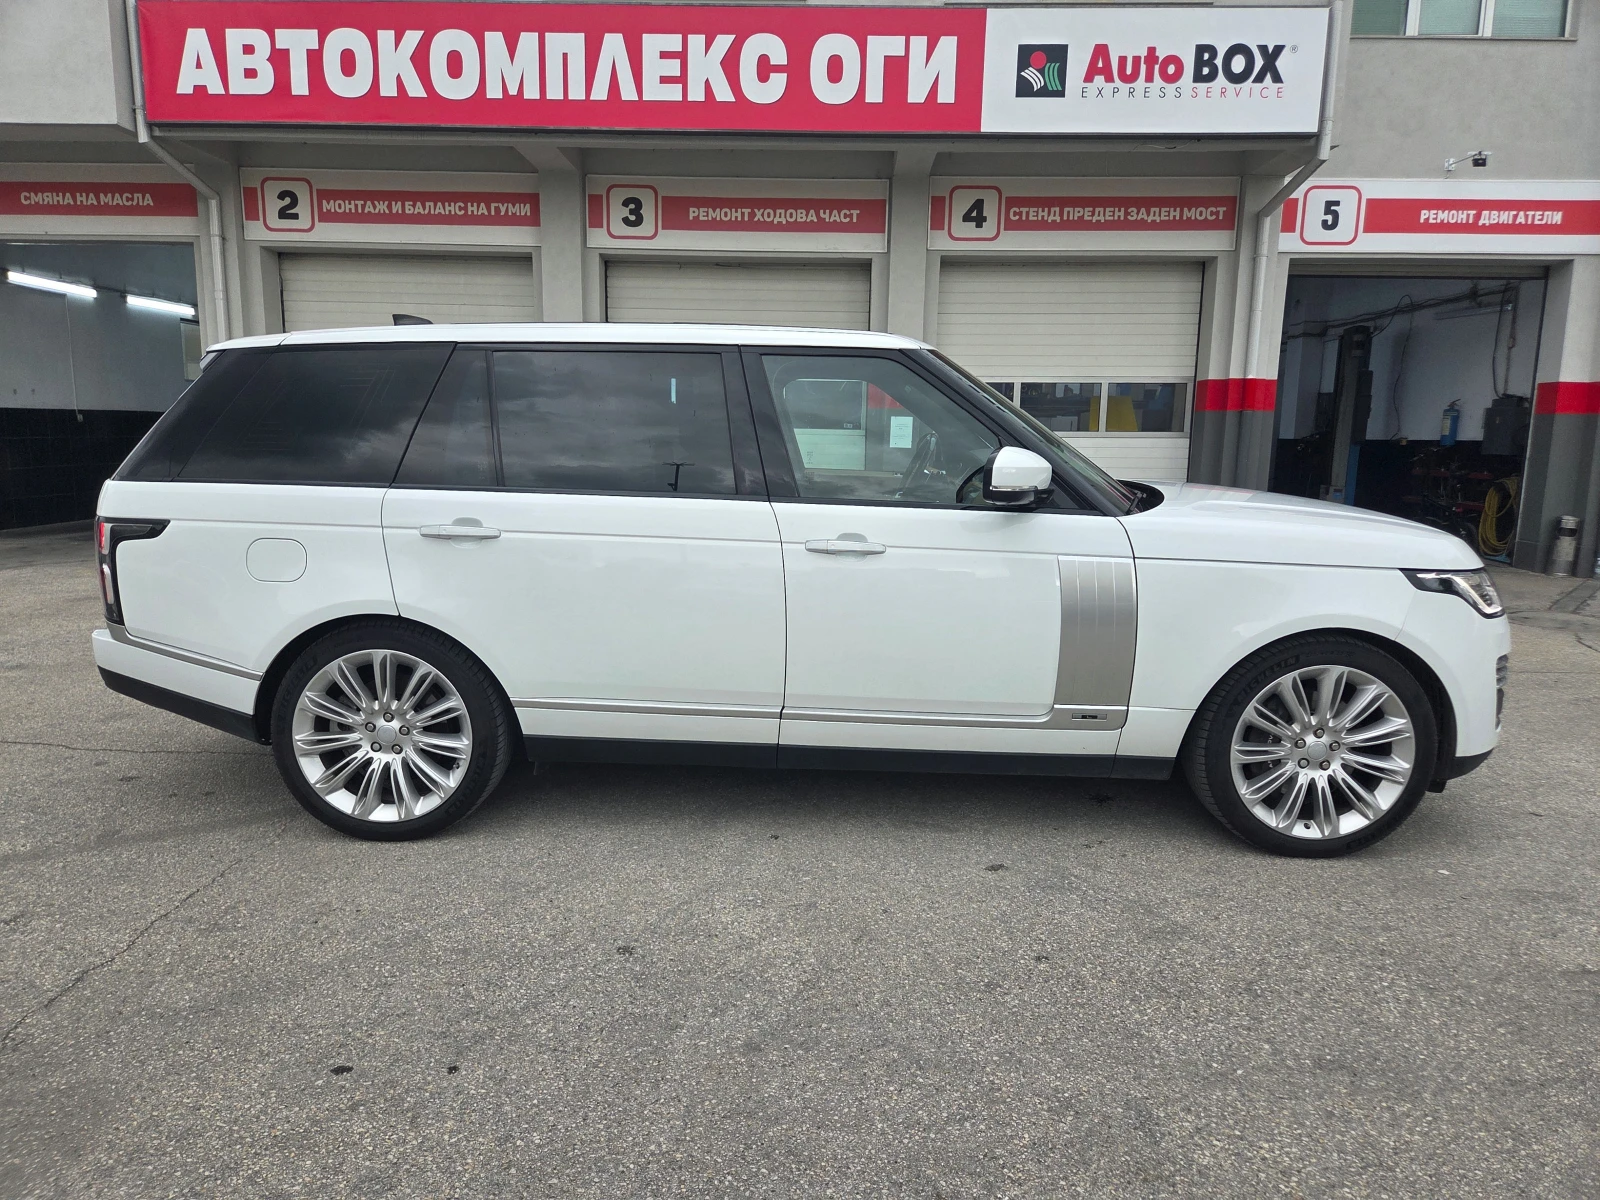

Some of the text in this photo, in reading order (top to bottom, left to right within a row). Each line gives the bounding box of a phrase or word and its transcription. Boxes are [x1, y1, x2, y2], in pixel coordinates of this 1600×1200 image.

[176, 28, 958, 105] АВТОКОМПЛЕКС ОГИ
[1083, 43, 1286, 85] Auto BOX
[1081, 86, 1284, 99] EXPRESS SERVICE
[20, 192, 154, 207] СМЯНА НА МАСЛА
[276, 189, 300, 221] 2
[322, 199, 531, 217] МОНТАЖ И БАЛАНС НА ГУМИ
[621, 196, 644, 228] 3
[689, 207, 860, 224] РЕМОНТ ХОДОВА ЧАСТ
[961, 198, 988, 229] 4
[1009, 206, 1227, 223] СТЕНД ПРЕДЕН ЗАДЕН МОСТ
[1321, 200, 1341, 231] 5
[1420, 209, 1564, 226] РЕМОНТ ДВИГАТЕЛИ
